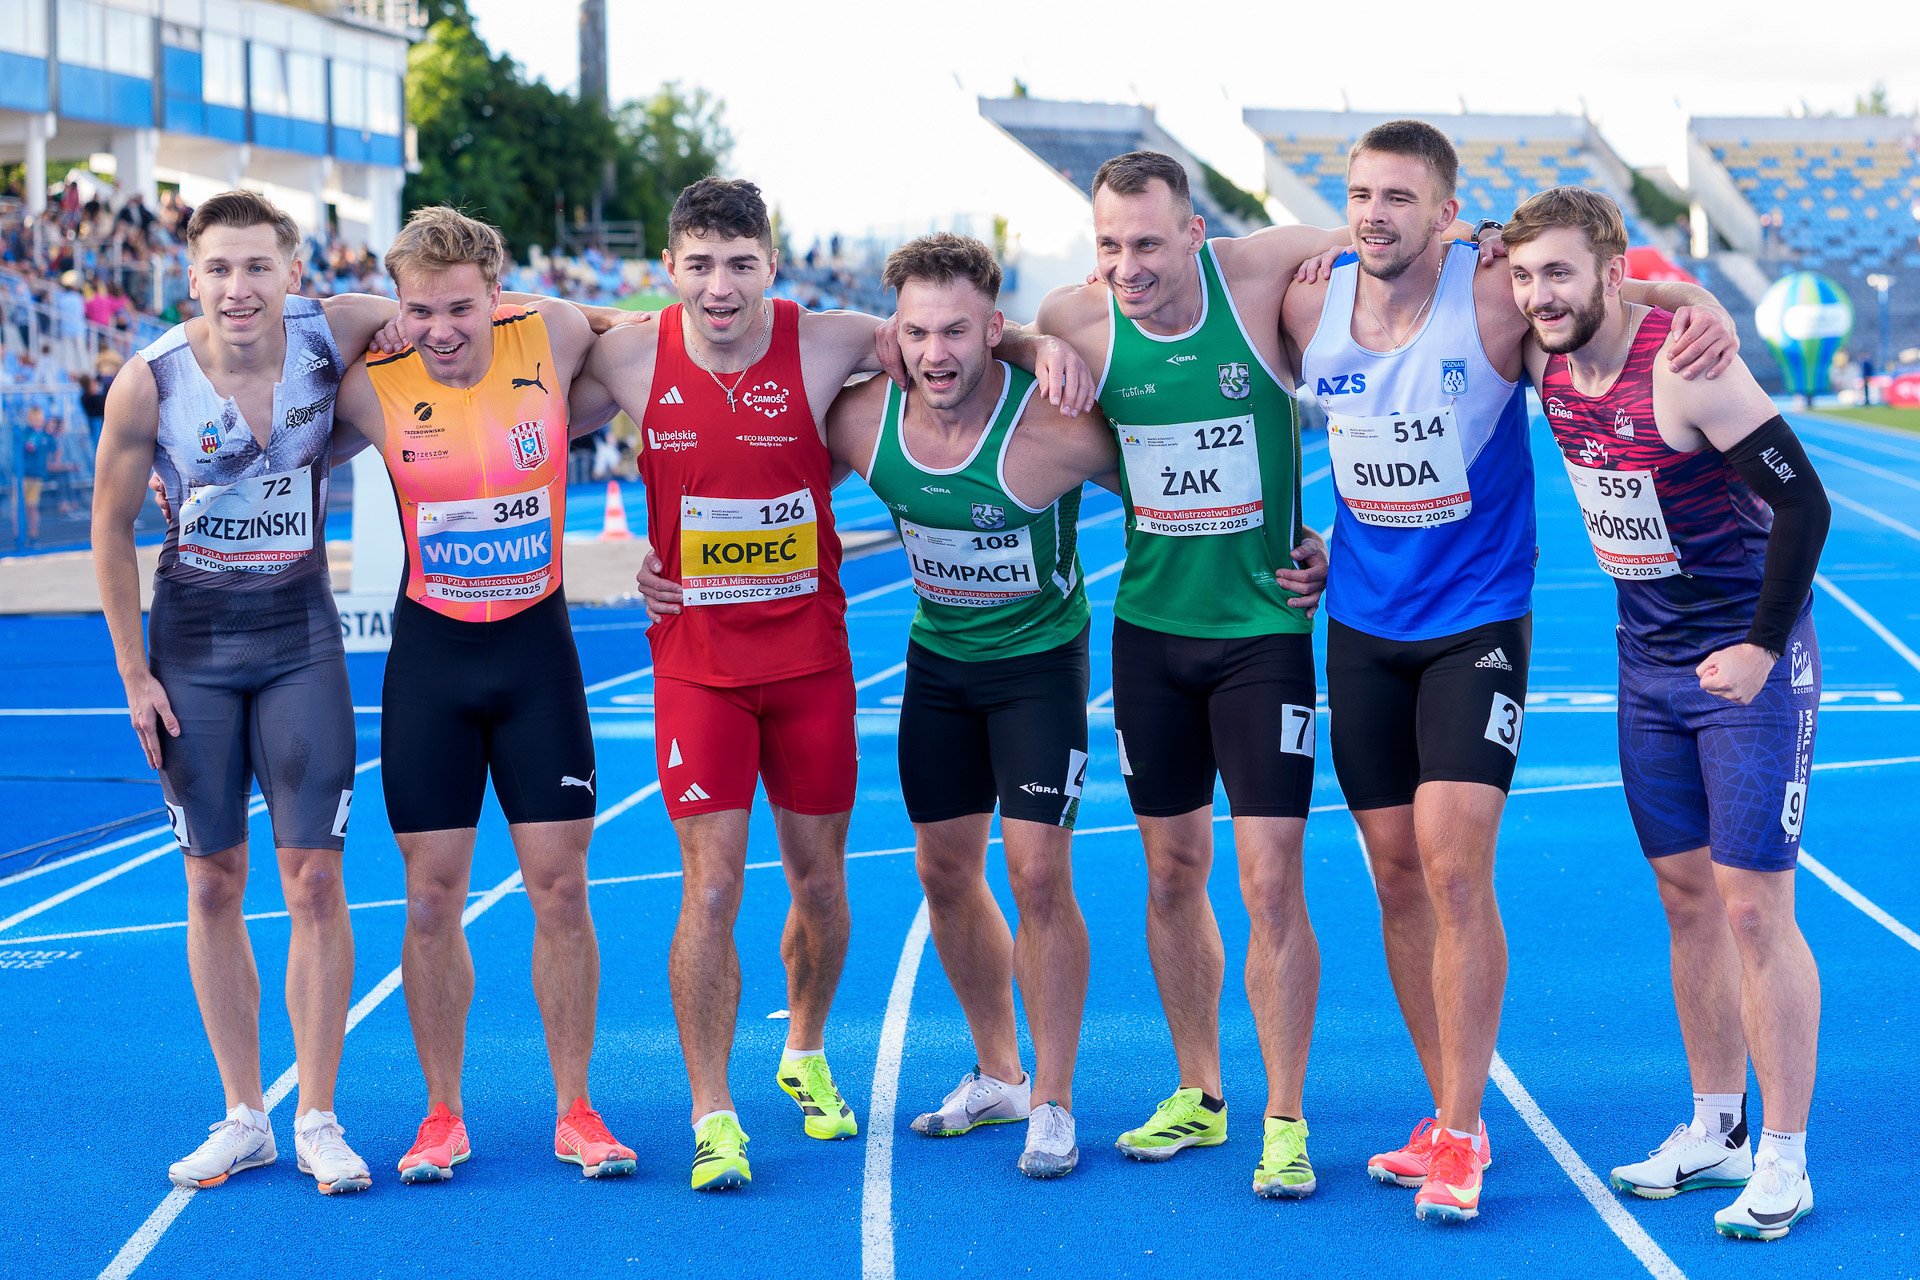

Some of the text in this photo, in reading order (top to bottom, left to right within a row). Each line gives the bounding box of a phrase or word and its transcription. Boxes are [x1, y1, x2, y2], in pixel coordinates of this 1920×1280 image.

[293, 357, 329, 379] adidas
[1317, 373, 1366, 396] AZS
[753, 394, 786, 403] ZAMOŚĆ
[1549, 403, 1573, 419] Enea
[1194, 424, 1244, 450] 122
[1394, 416, 1444, 443] 514
[1160, 466, 1222, 496] ŻAK
[1353, 460, 1440, 487] SIUDA
[262, 477, 292, 500] 72
[1598, 476, 1642, 499] 559
[493, 496, 540, 524] 348
[759, 498, 805, 525] 126
[1153, 510, 1172, 520] PZLA
[1173, 508, 1229, 520] Mistrzostwa
[1230, 502, 1256, 515] Polski
[1360, 501, 1379, 511] PZLA
[1381, 500, 1434, 511] Mistrzostwa
[1436, 495, 1464, 508] Polski
[184, 510, 307, 541] BRZEZIŃSKI
[1150, 518, 1249, 533] BYDGOSZCZ 2025
[1358, 509, 1455, 524] BYDGOSZCZ 2025
[186, 544, 200, 554] 101.
[202, 548, 221, 560] PZLA
[223, 552, 277, 562] Mistrzostwa
[424, 531, 548, 566] WDOWIK
[702, 532, 797, 565] KOPEĆ
[971, 533, 1019, 551] 108
[195, 556, 265, 572] BYDGOSZCZ
[912, 553, 1031, 583] LEMPACH
[1641, 554, 1669, 564] Polski
[431, 569, 548, 587] 101. PZLA Mistrzostwa Polski
[689, 570, 811, 588] 101. PZLA Mistrzostwa Polski
[1632, 567, 1662, 576] 2025
[442, 583, 541, 599] BYDGOSZCZ 2025
[700, 584, 802, 601] BYDGOSZCZ 2025
[929, 593, 997, 606] BYDGOSZCZ
[933, 586, 952, 595] PZLA
[953, 590, 1007, 598] Mistrzostwa
[340, 612, 393, 638] STA
[1474, 659, 1513, 671] adidas
[1292, 709, 1311, 750] 7
[1498, 703, 1517, 745] 3
[1802, 709, 1813, 750] MKL
[1788, 791, 1800, 826] 9
